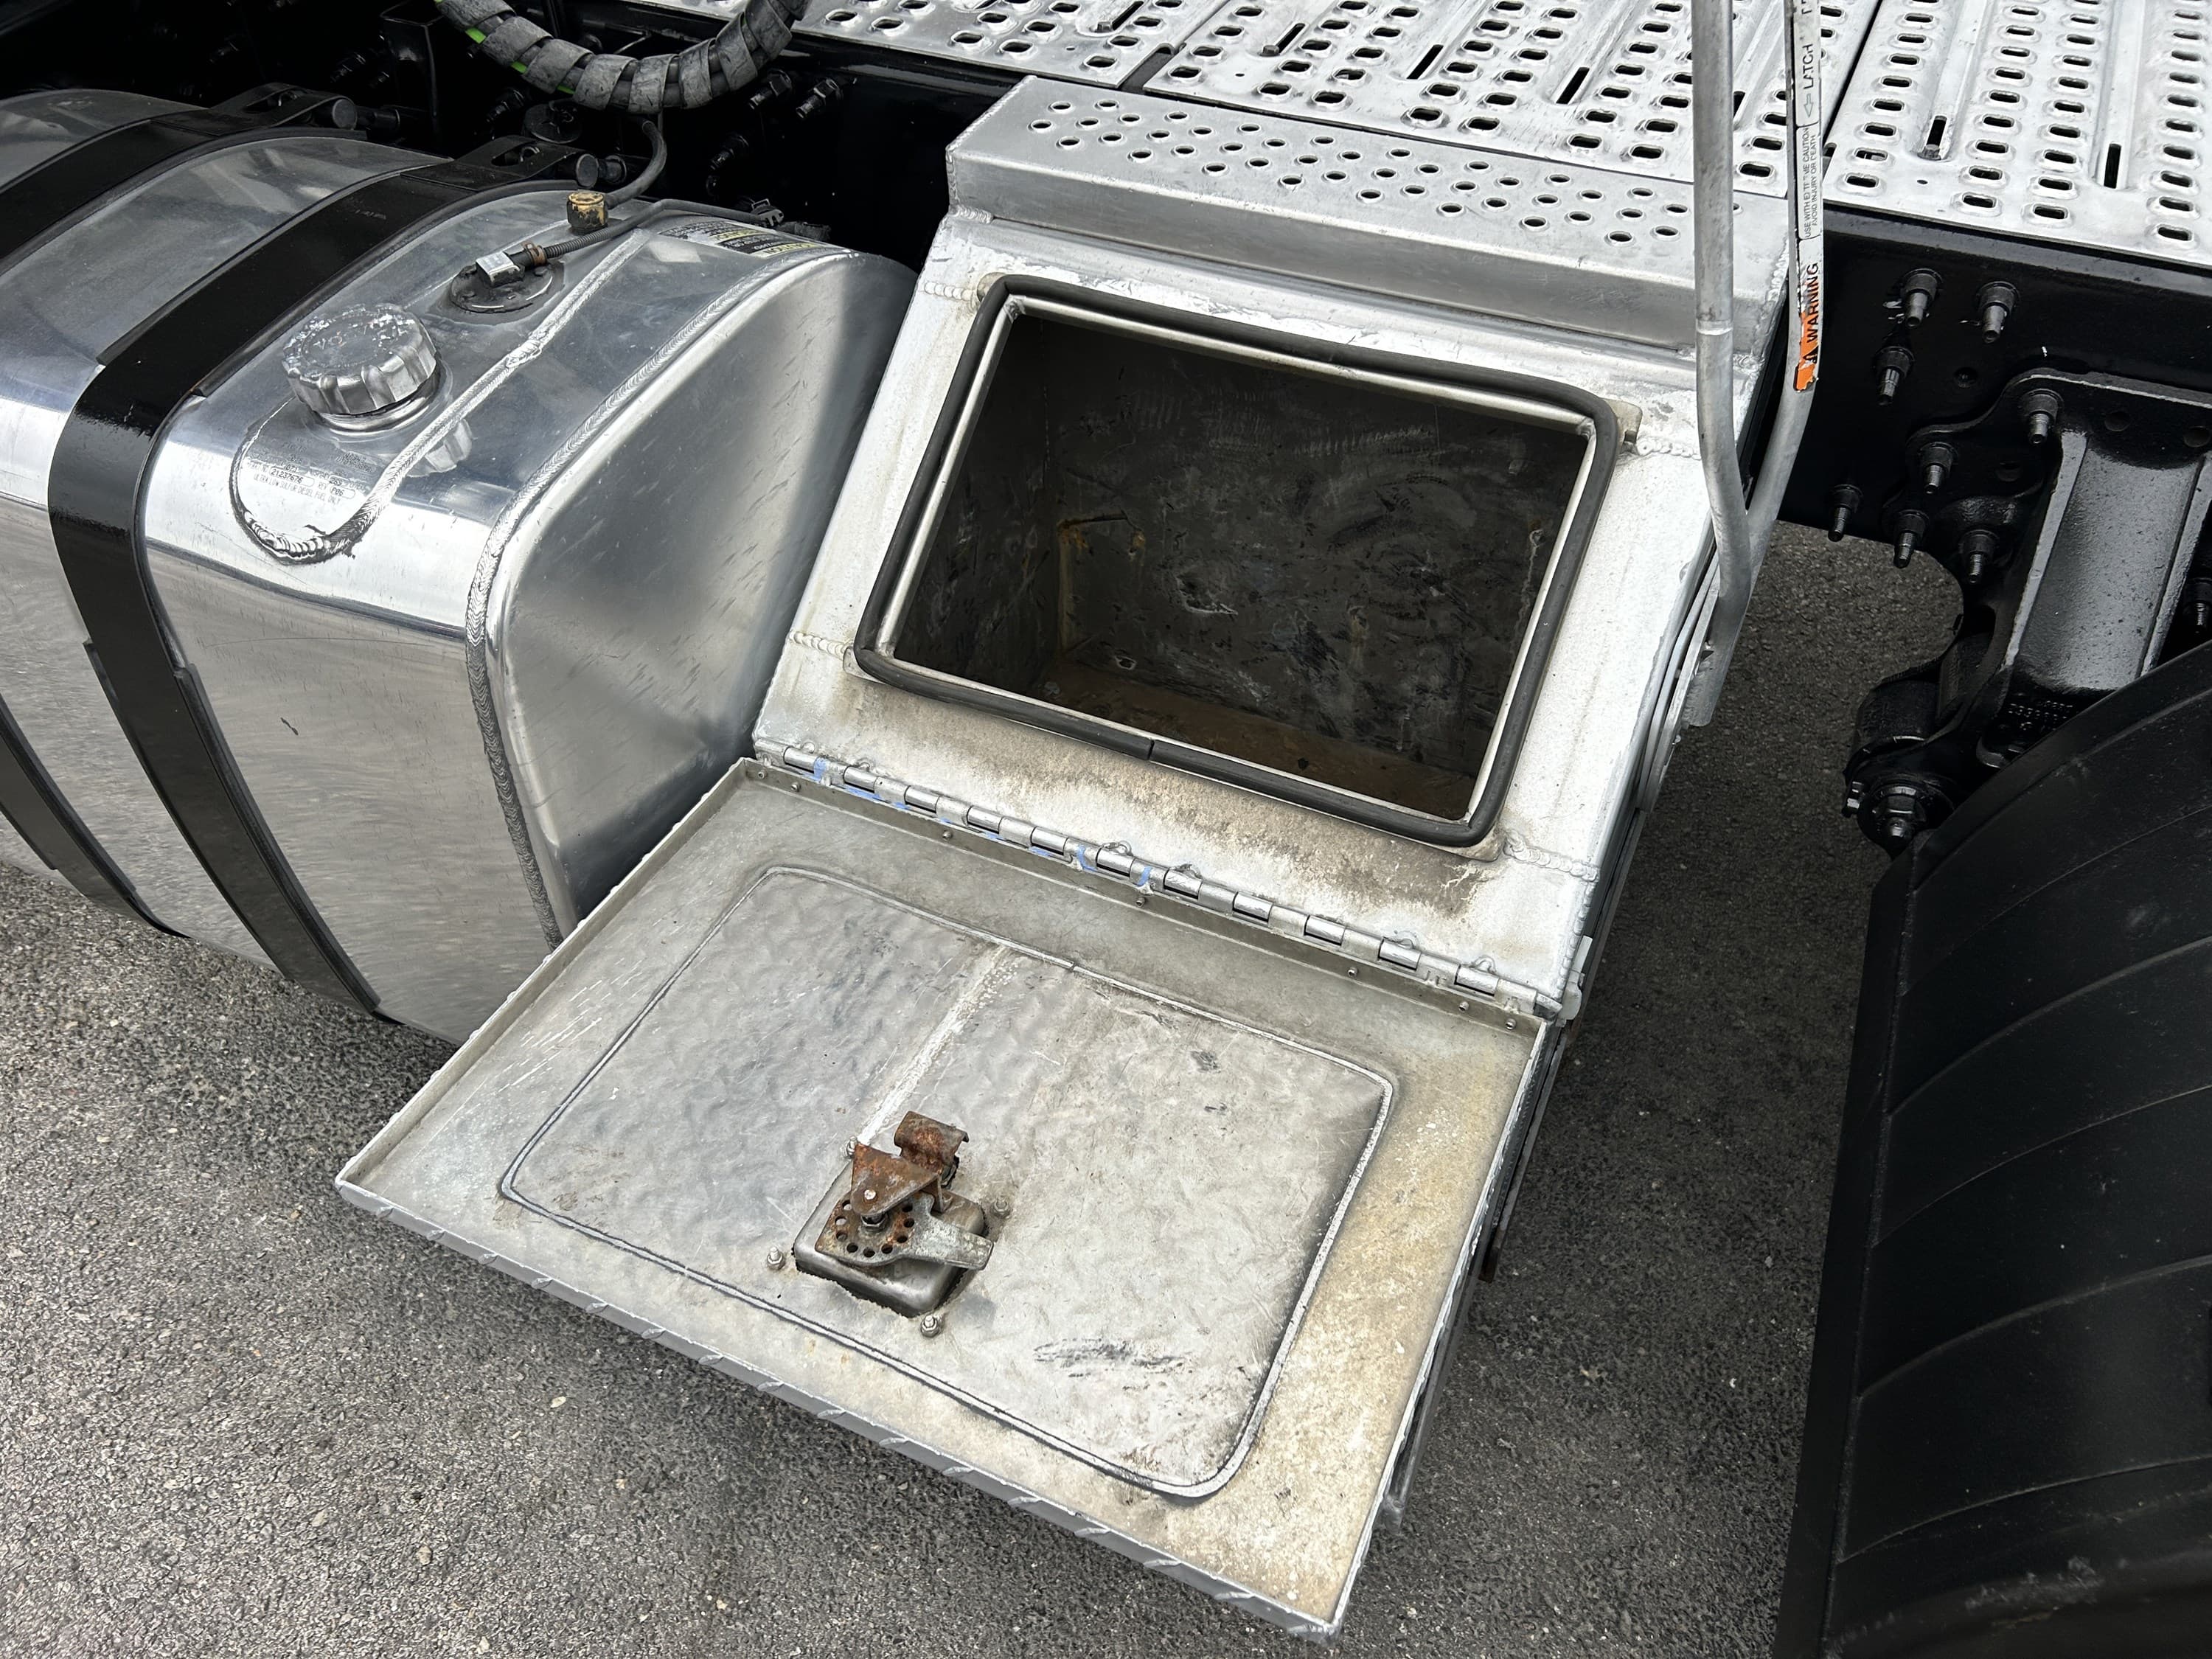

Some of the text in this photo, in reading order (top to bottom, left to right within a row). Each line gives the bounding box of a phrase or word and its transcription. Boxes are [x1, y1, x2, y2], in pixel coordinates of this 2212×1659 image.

[1802, 44, 1814, 89] LATCH
[1809, 162, 1817, 174] OR
[1804, 222, 1812, 237] USE
[1806, 262, 1819, 343] WARNING
